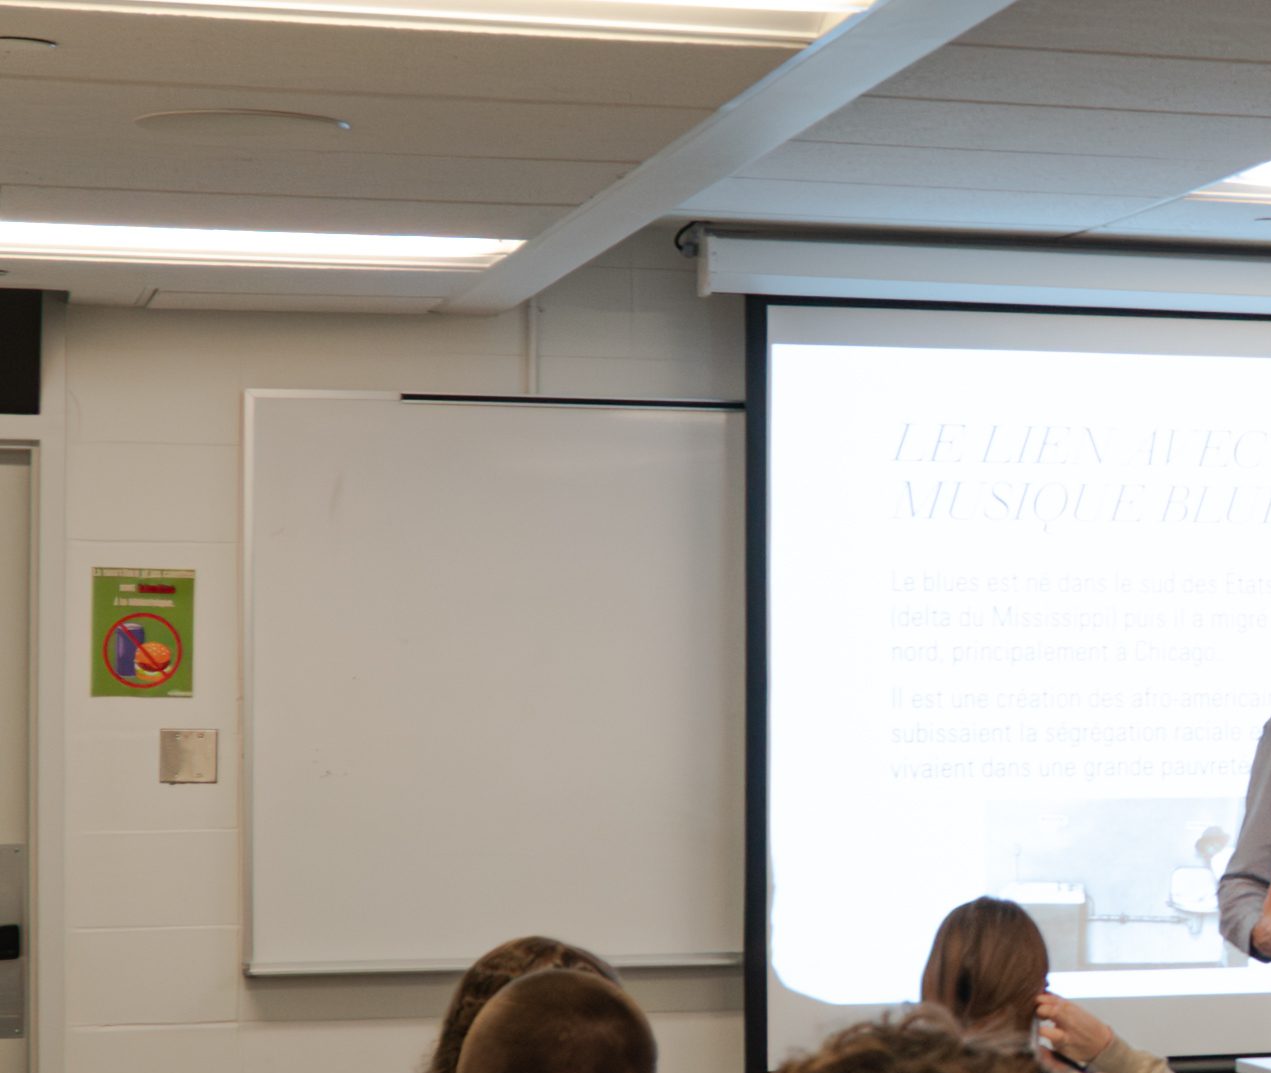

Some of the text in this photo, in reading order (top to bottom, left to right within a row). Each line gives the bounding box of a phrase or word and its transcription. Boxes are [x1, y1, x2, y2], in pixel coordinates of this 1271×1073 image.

[892, 420, 968, 465] LE
[982, 423, 1118, 467] LIEN
[1126, 426, 1268, 470] AVEC
[890, 480, 1147, 531] MUSIQUE
[891, 568, 916, 592] Le
[923, 569, 980, 593] blues
[987, 574, 1018, 593] est
[1057, 571, 1108, 593] dans
[1114, 569, 1133, 593] le
[1141, 569, 1176, 594] sud
[1182, 569, 1218, 594] des
[959, 603, 984, 628] du
[1124, 608, 1167, 632] puis
[951, 640, 1109, 667] principalement
[891, 687, 903, 708] Il
[911, 690, 944, 709] est
[951, 691, 989, 709] une
[996, 687, 1080, 709] création
[1087, 688, 1124, 709] des
[890, 722, 1013, 744] subissaient
[1019, 721, 1039, 743] la
[1174, 721, 1241, 743] raciale
[890, 758, 974, 780] vivaient
[982, 756, 1032, 779] dans
[1039, 760, 1077, 778] une
[1083, 756, 1153, 782] grande
